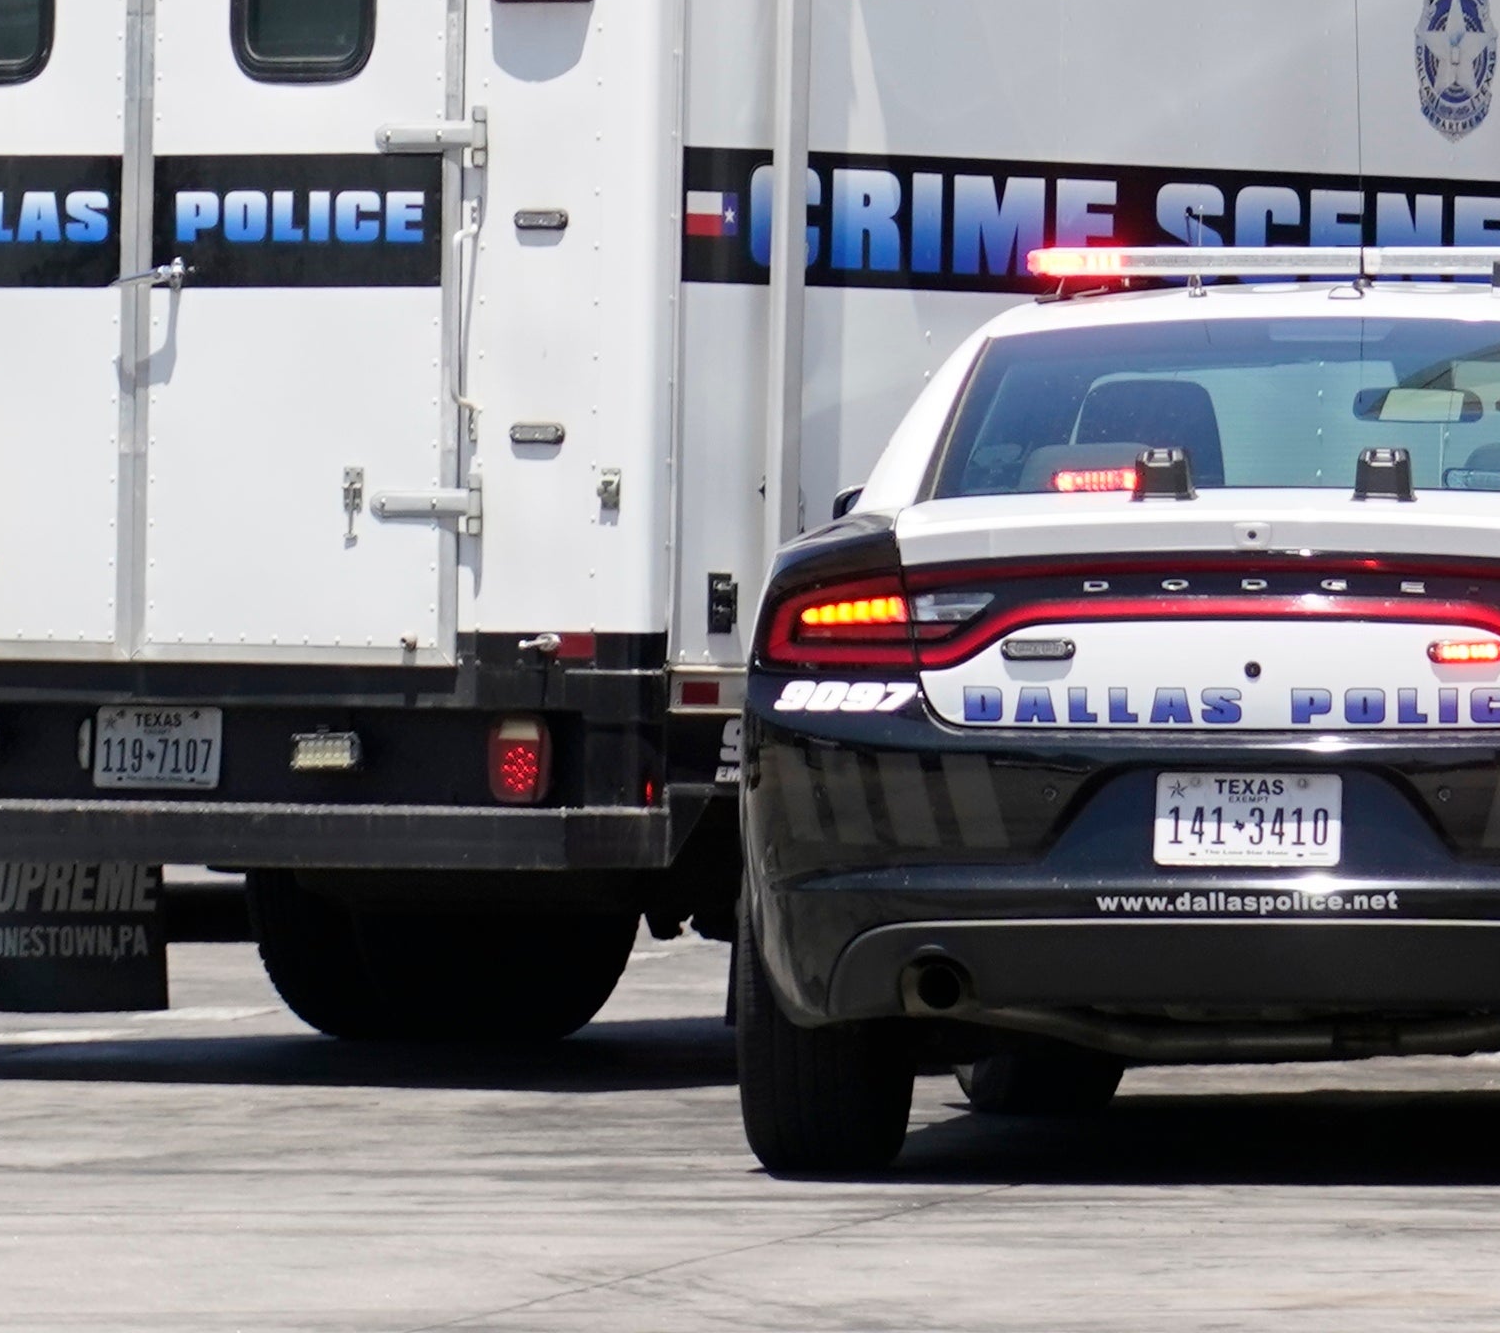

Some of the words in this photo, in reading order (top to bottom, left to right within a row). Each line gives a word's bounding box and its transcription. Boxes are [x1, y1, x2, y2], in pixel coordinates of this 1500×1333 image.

[175, 189, 424, 242] POLICE
[750, 163, 1118, 276] CRIME
[1083, 578, 1426, 594] DODGE
[773, 680, 918, 712] 9097
[962, 686, 1243, 724] DALLAS
[134, 712, 182, 727] TEXAS
[1214, 779, 1284, 796] TEXAS
[1229, 796, 1270, 804] EXEMPT
[1096, 890, 1399, 915] www.dallaspolice.net
